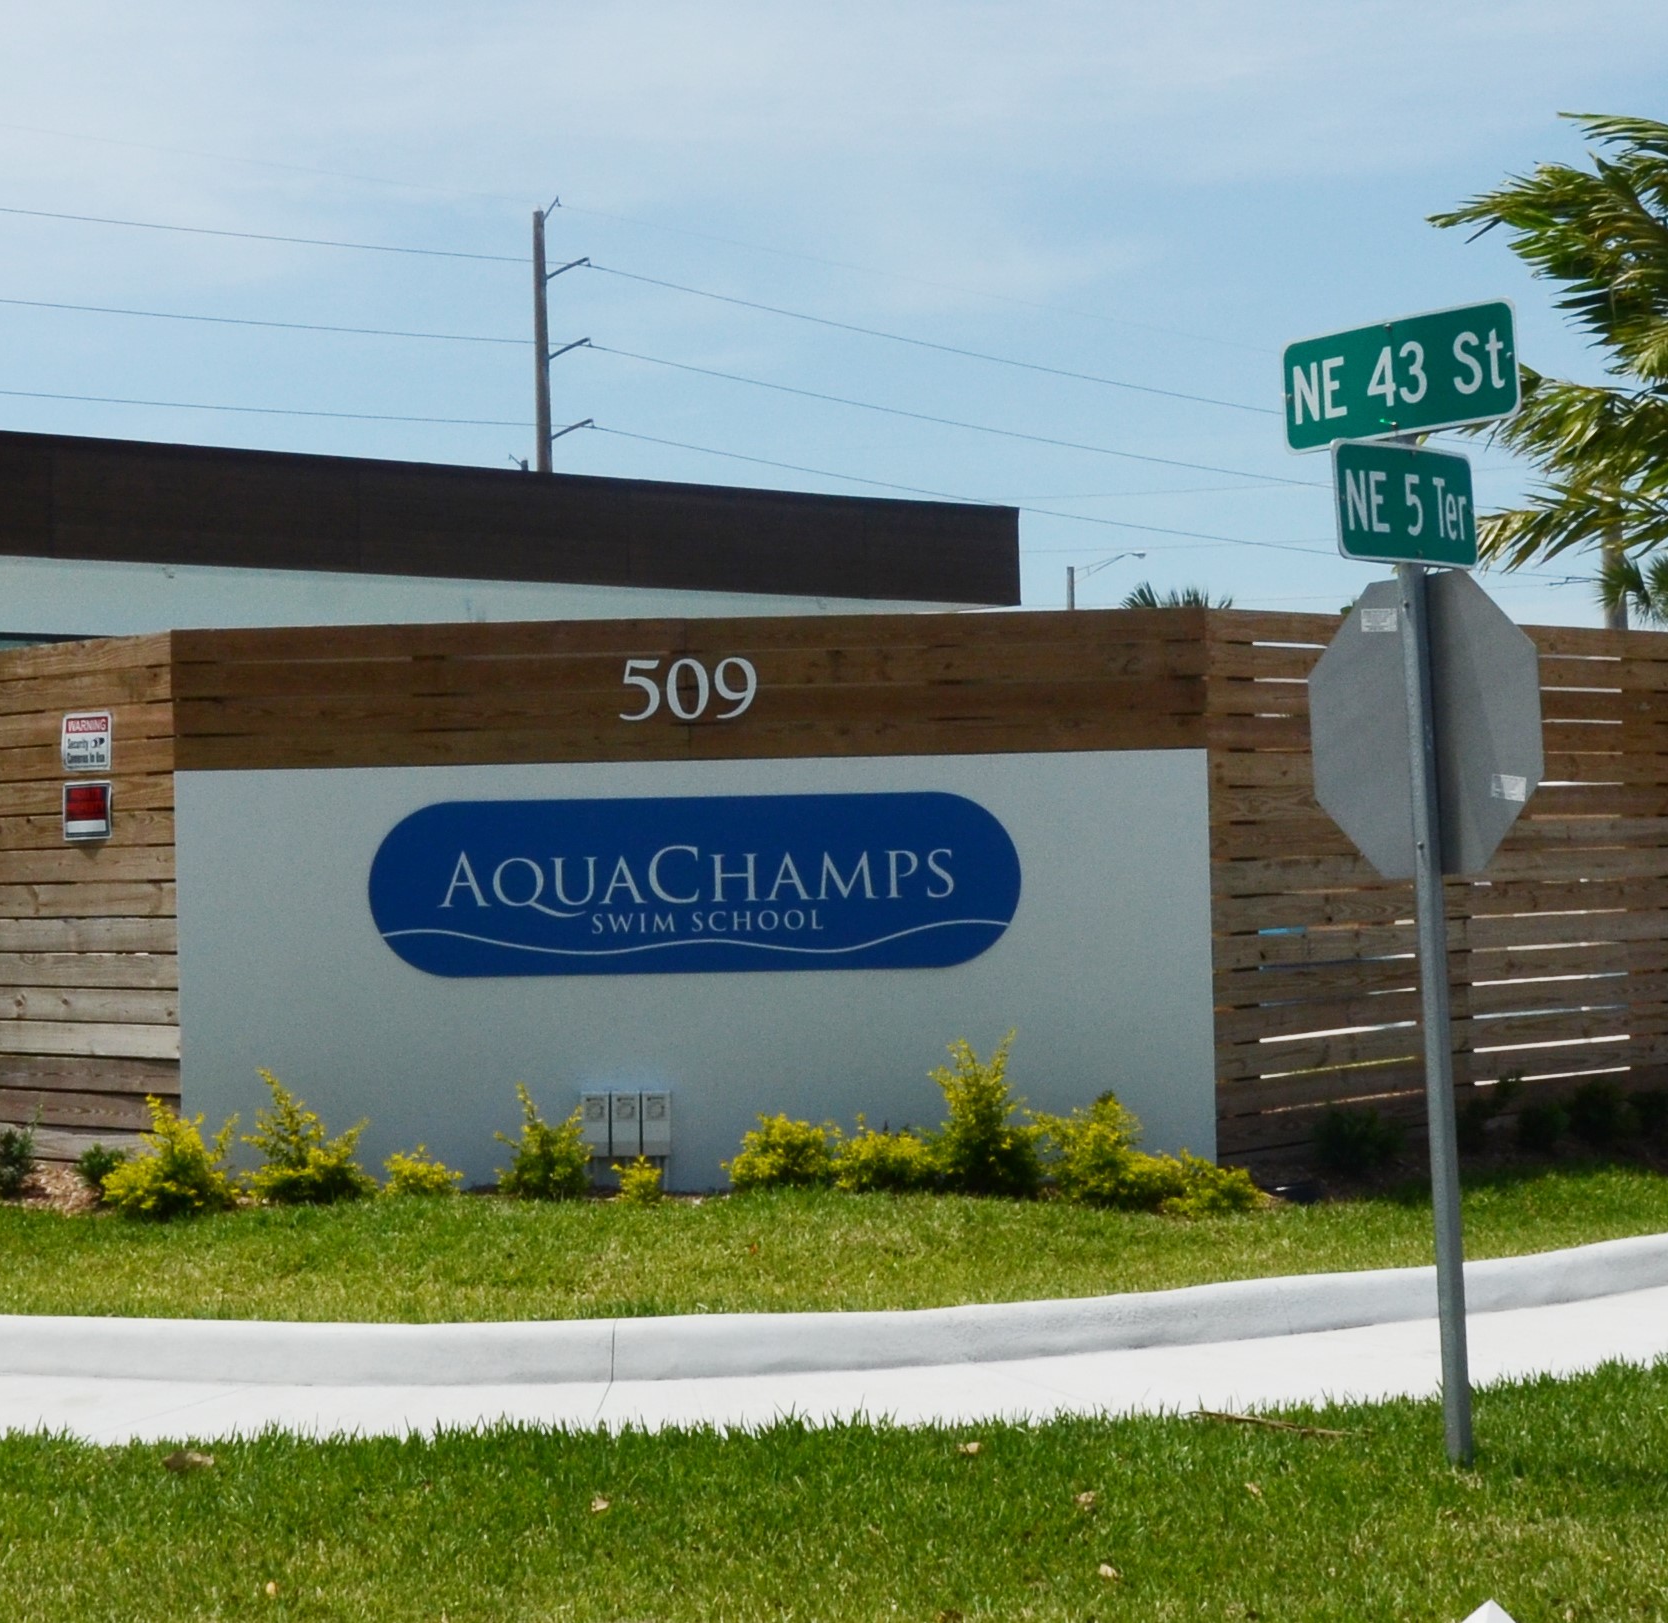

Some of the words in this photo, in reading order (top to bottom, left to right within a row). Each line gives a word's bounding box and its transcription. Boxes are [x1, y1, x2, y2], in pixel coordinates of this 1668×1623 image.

[1292, 356, 1348, 426] NE
[1367, 340, 1428, 407] 43
[1453, 328, 1506, 396] St
[1345, 468, 1391, 533] NE
[1404, 473, 1424, 537] 5
[1432, 476, 1468, 541] Ter
[619, 656, 758, 722] 509
[68, 718, 106, 732] WARNING
[437, 845, 955, 918] AQUACHAMPS
[591, 912, 677, 935] SWIM
[692, 909, 824, 933] SCHOOL
